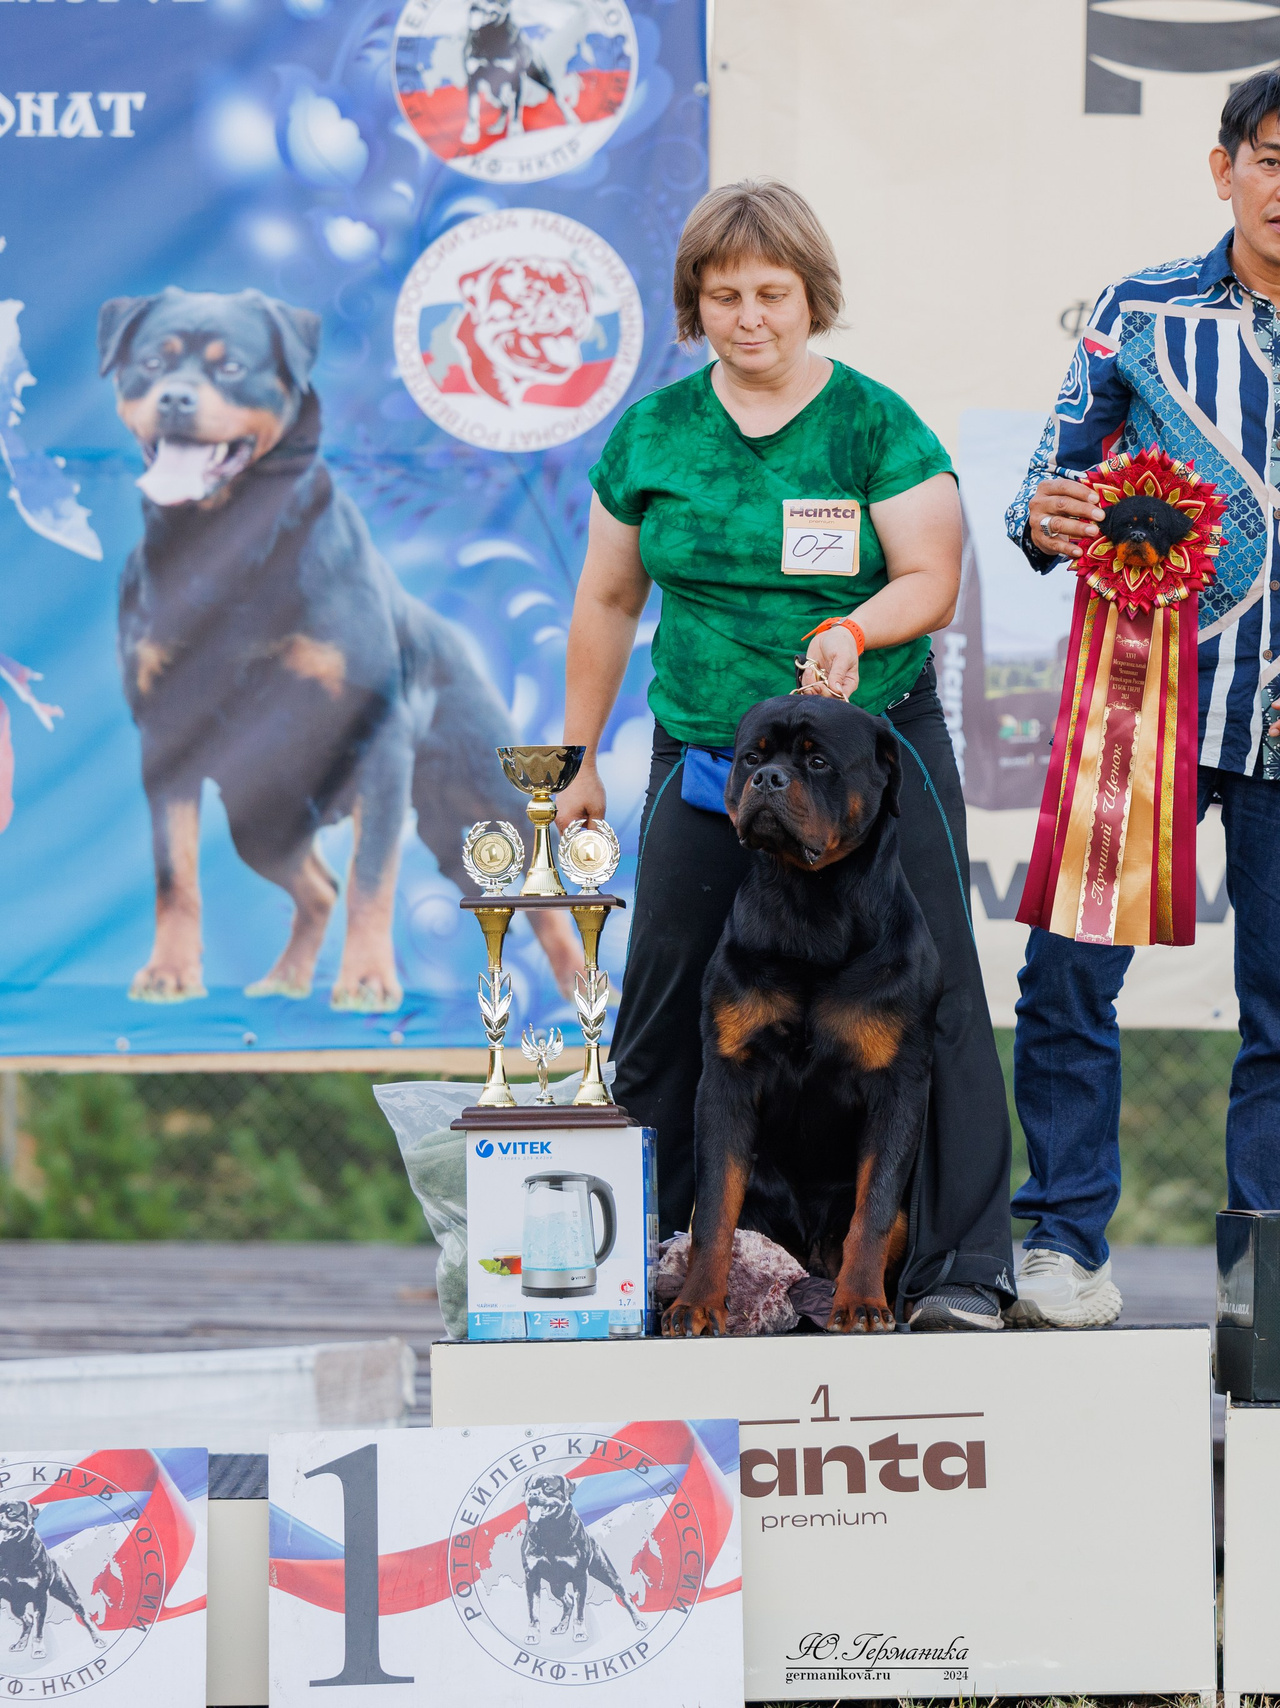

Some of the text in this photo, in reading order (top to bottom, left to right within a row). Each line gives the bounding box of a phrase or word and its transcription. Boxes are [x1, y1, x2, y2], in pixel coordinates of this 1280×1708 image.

[789, 506, 855, 519] Hanta
[792, 532, 844, 564] 07
[1091, 743, 1123, 906] Лучший Щенок
[497, 1141, 553, 1155] VITEK
[474, 1314, 481, 1326] 1
[534, 1312, 542, 1325] 2
[581, 1312, 589, 1325] 3
[810, 1384, 840, 1423] 1
[740, 1432, 987, 1498] anta
[452, 1437, 701, 1622] РОТВЕЙЛЕР КЛУБ РОССИИ
[761, 1509, 888, 1533] premium
[32, 1466, 162, 1633] КЛУБ РОССИИ
[303, 1443, 415, 1688] 1
[0, 1658, 107, 1696] Ф-НКПР
[513, 1641, 651, 1682] РКФ-НКПР
